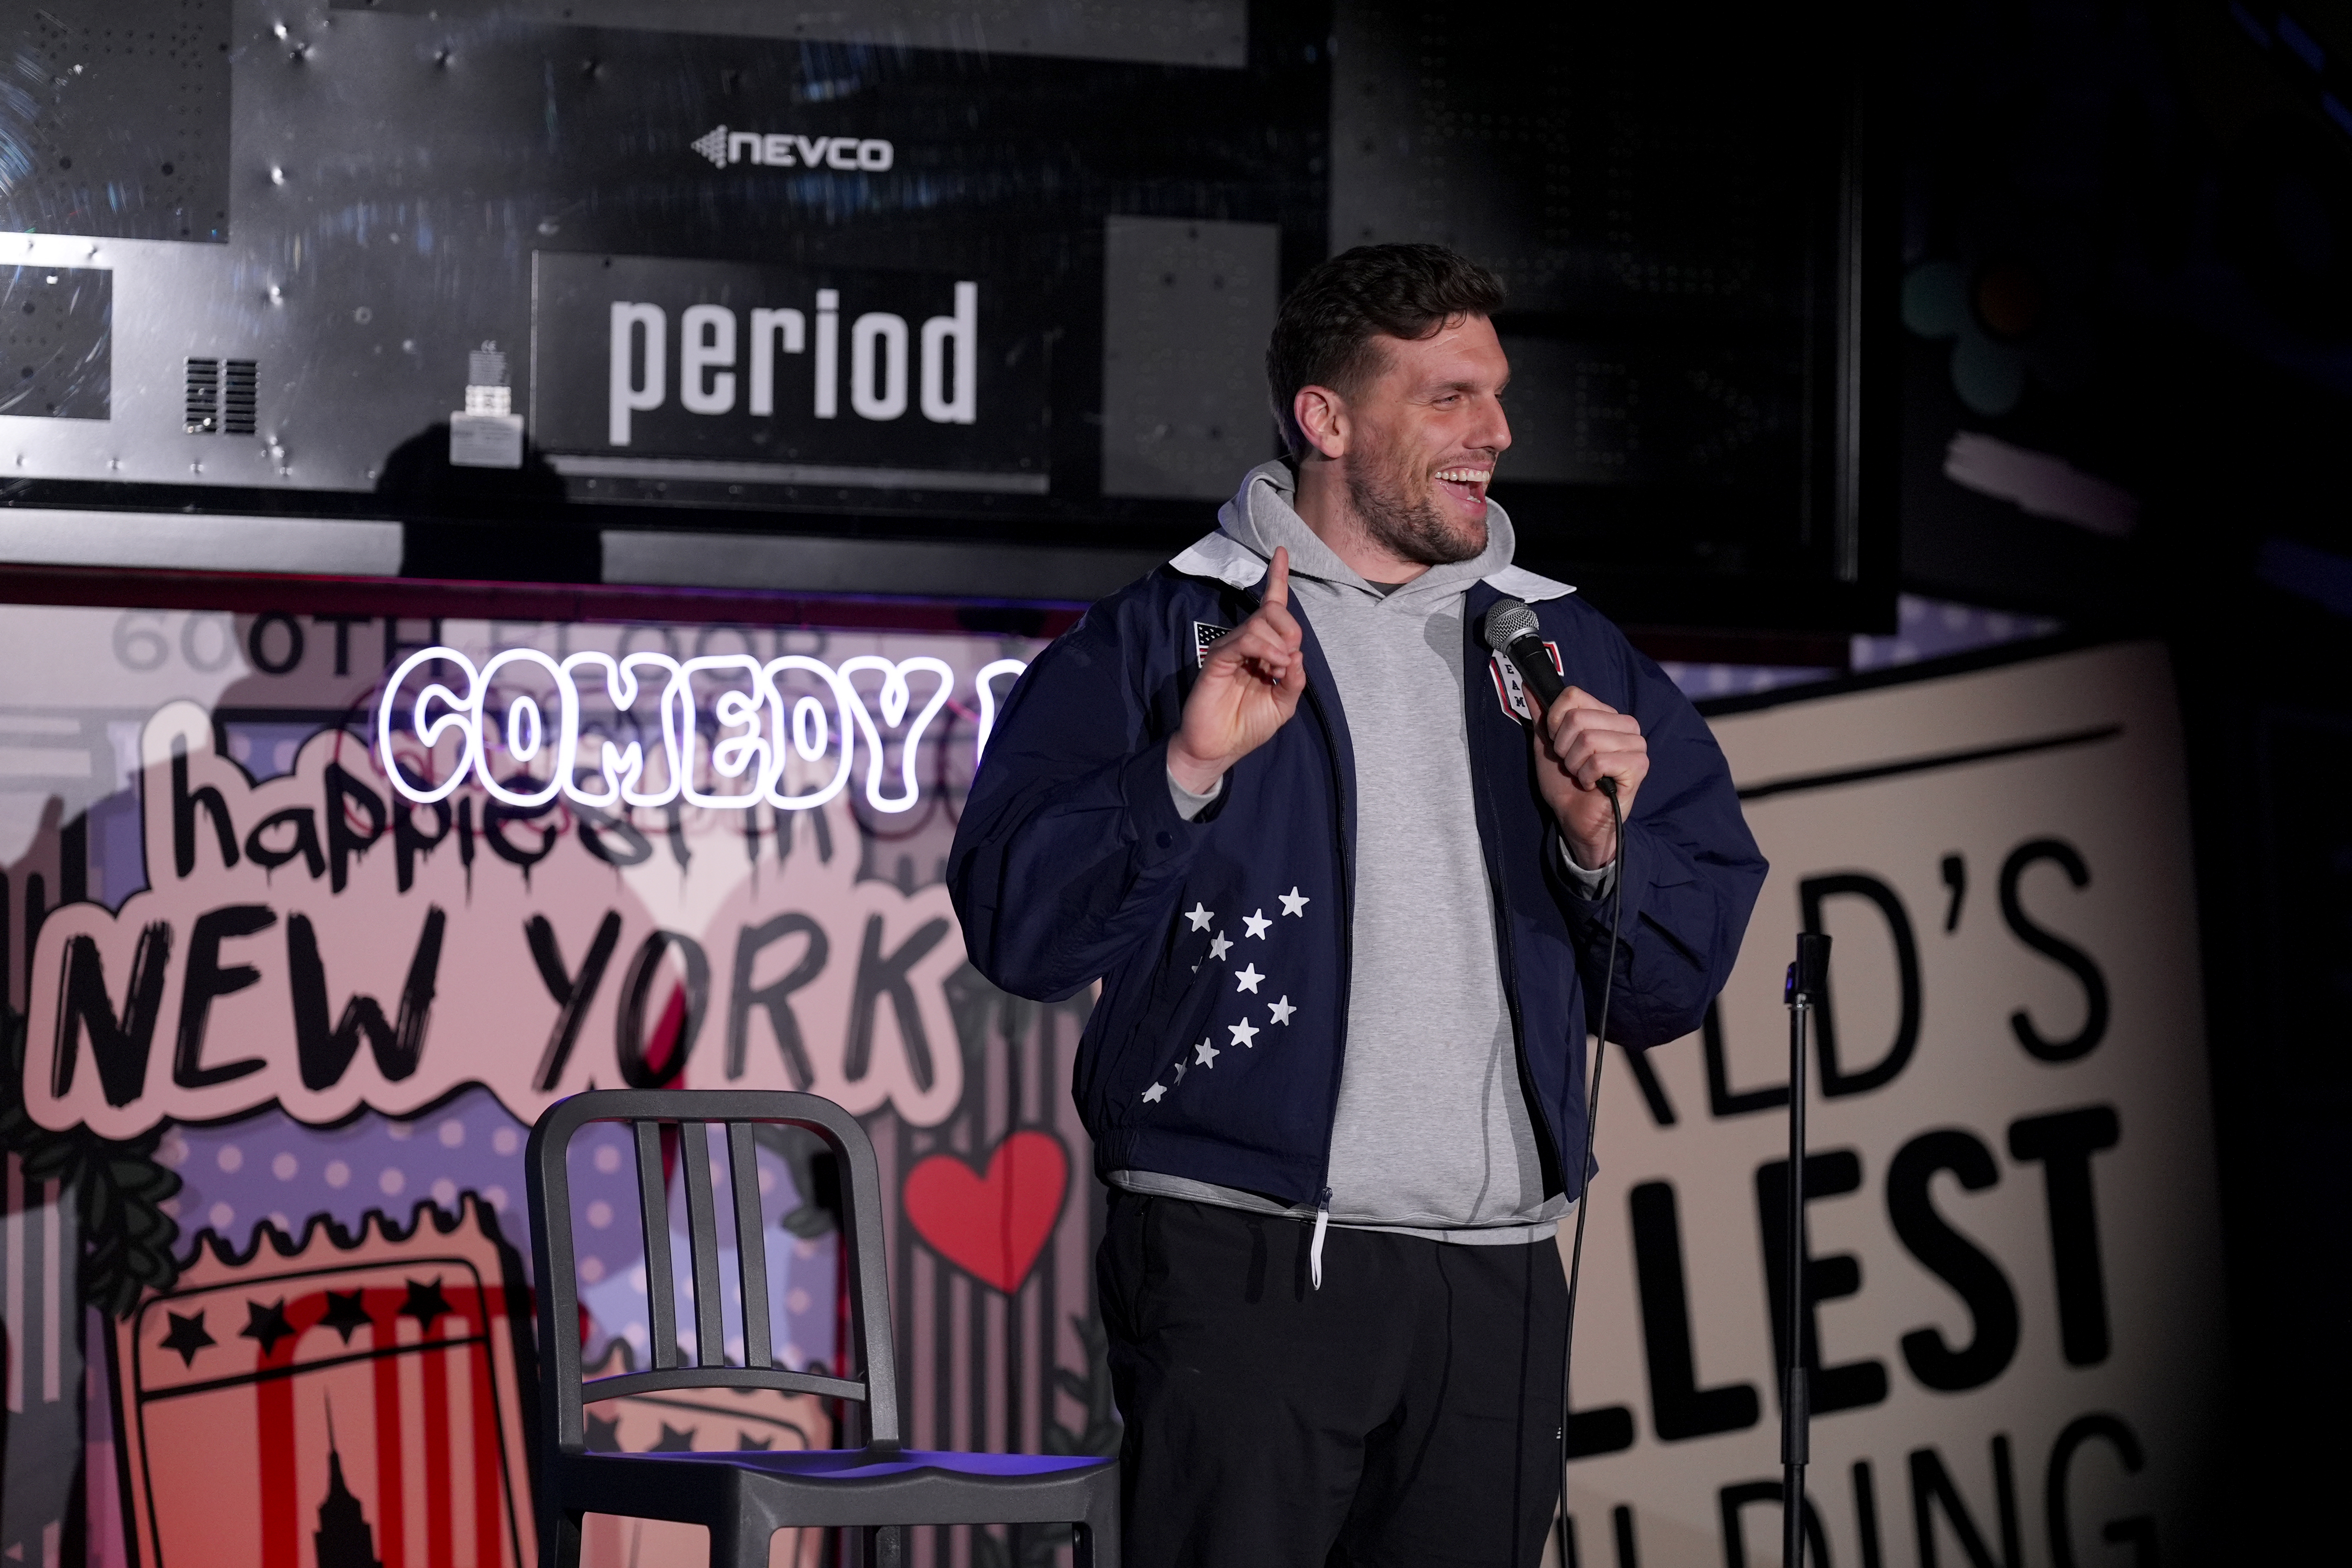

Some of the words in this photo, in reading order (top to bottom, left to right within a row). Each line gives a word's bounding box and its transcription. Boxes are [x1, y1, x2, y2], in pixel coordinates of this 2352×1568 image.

[727, 131, 894, 173] NEVCO
[609, 281, 978, 446] period
[112, 609, 442, 677] 600TH
[1503, 654, 1526, 708] EAM
[378, 646, 954, 813] COMEDY
[50, 903, 447, 1108] NEW
[523, 906, 951, 1094] YORK
[1624, 836, 2111, 1127] LD'S
